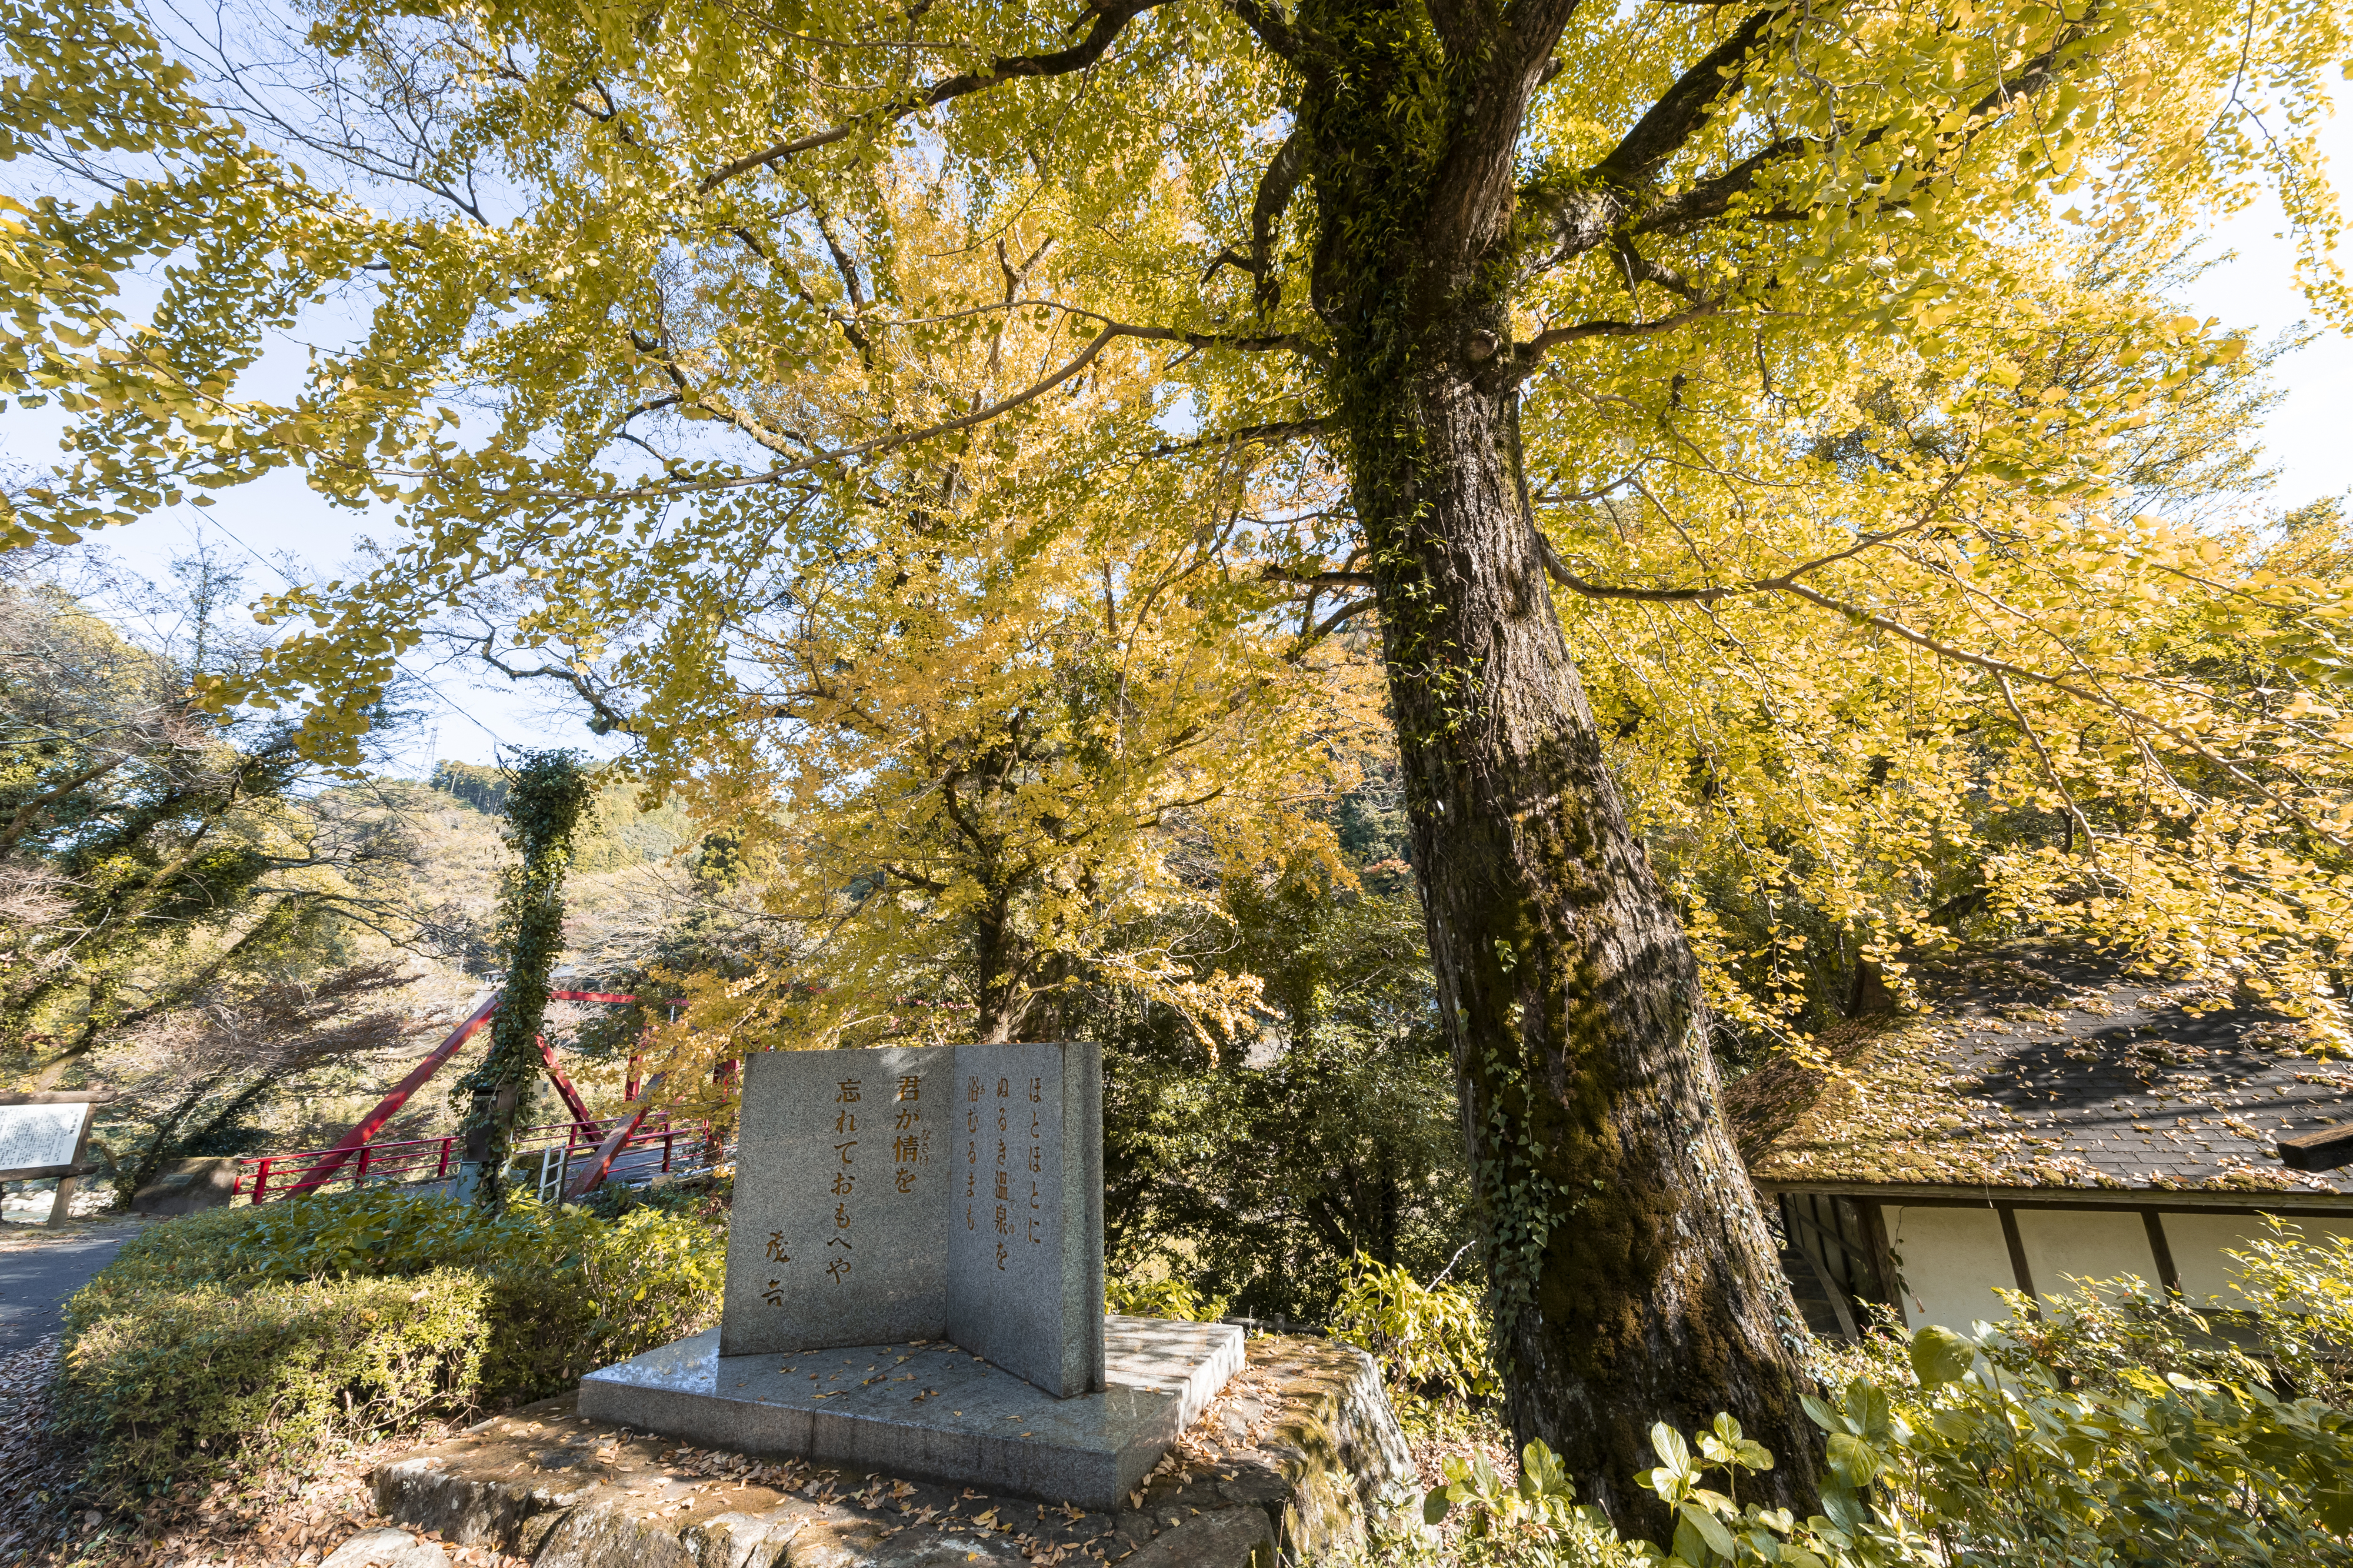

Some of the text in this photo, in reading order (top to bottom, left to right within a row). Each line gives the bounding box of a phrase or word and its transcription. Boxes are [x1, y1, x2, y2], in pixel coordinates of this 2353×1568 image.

[825, 1079, 861, 1285] 忘れておもへや
[892, 1075, 922, 1193] 君が情を
[919, 1129, 931, 1166] なさけ
[966, 1076, 979, 1231] 浴むるまも
[994, 1076, 1008, 1271] ぬるき温泉を
[1029, 1077, 1041, 1243] ほとほとに
